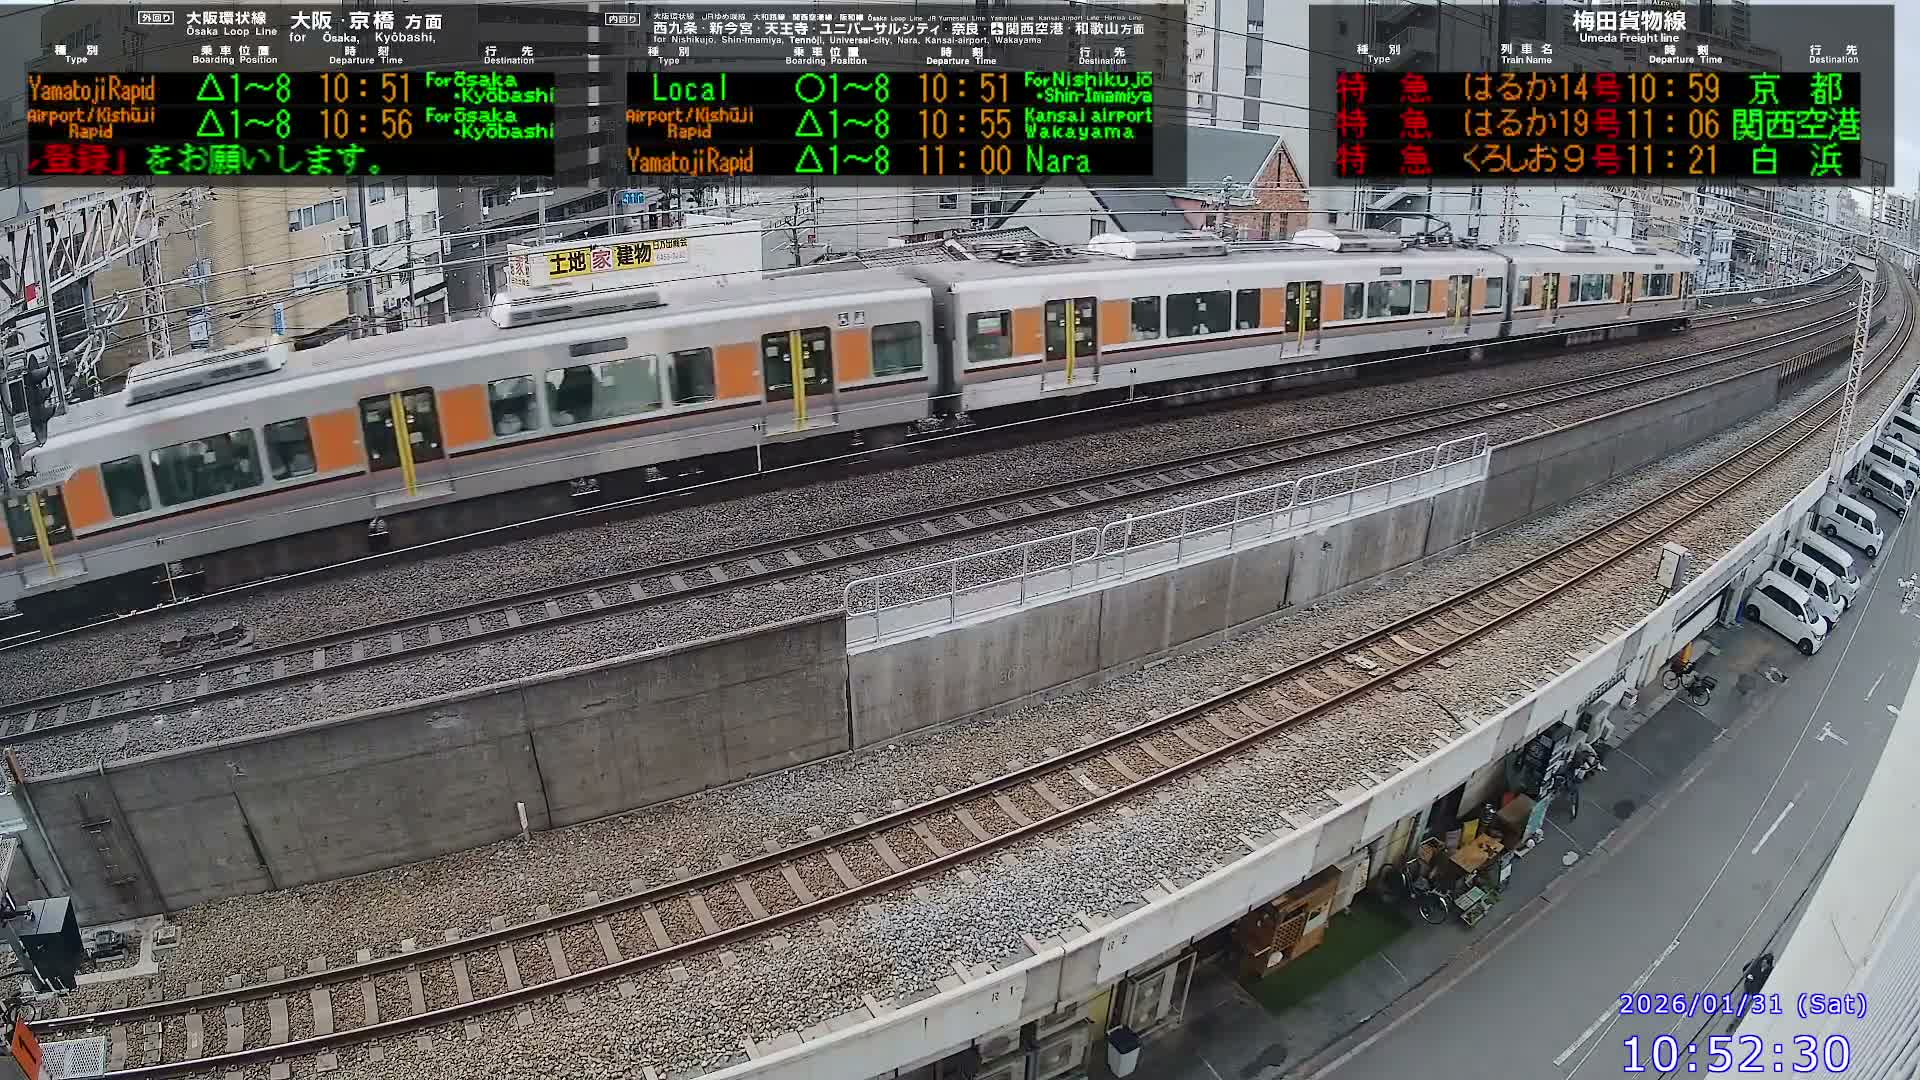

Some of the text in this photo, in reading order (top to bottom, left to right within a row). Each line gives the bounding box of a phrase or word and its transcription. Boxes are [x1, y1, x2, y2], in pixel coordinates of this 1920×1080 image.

[550, 242, 651, 275] 土地 家 建物
